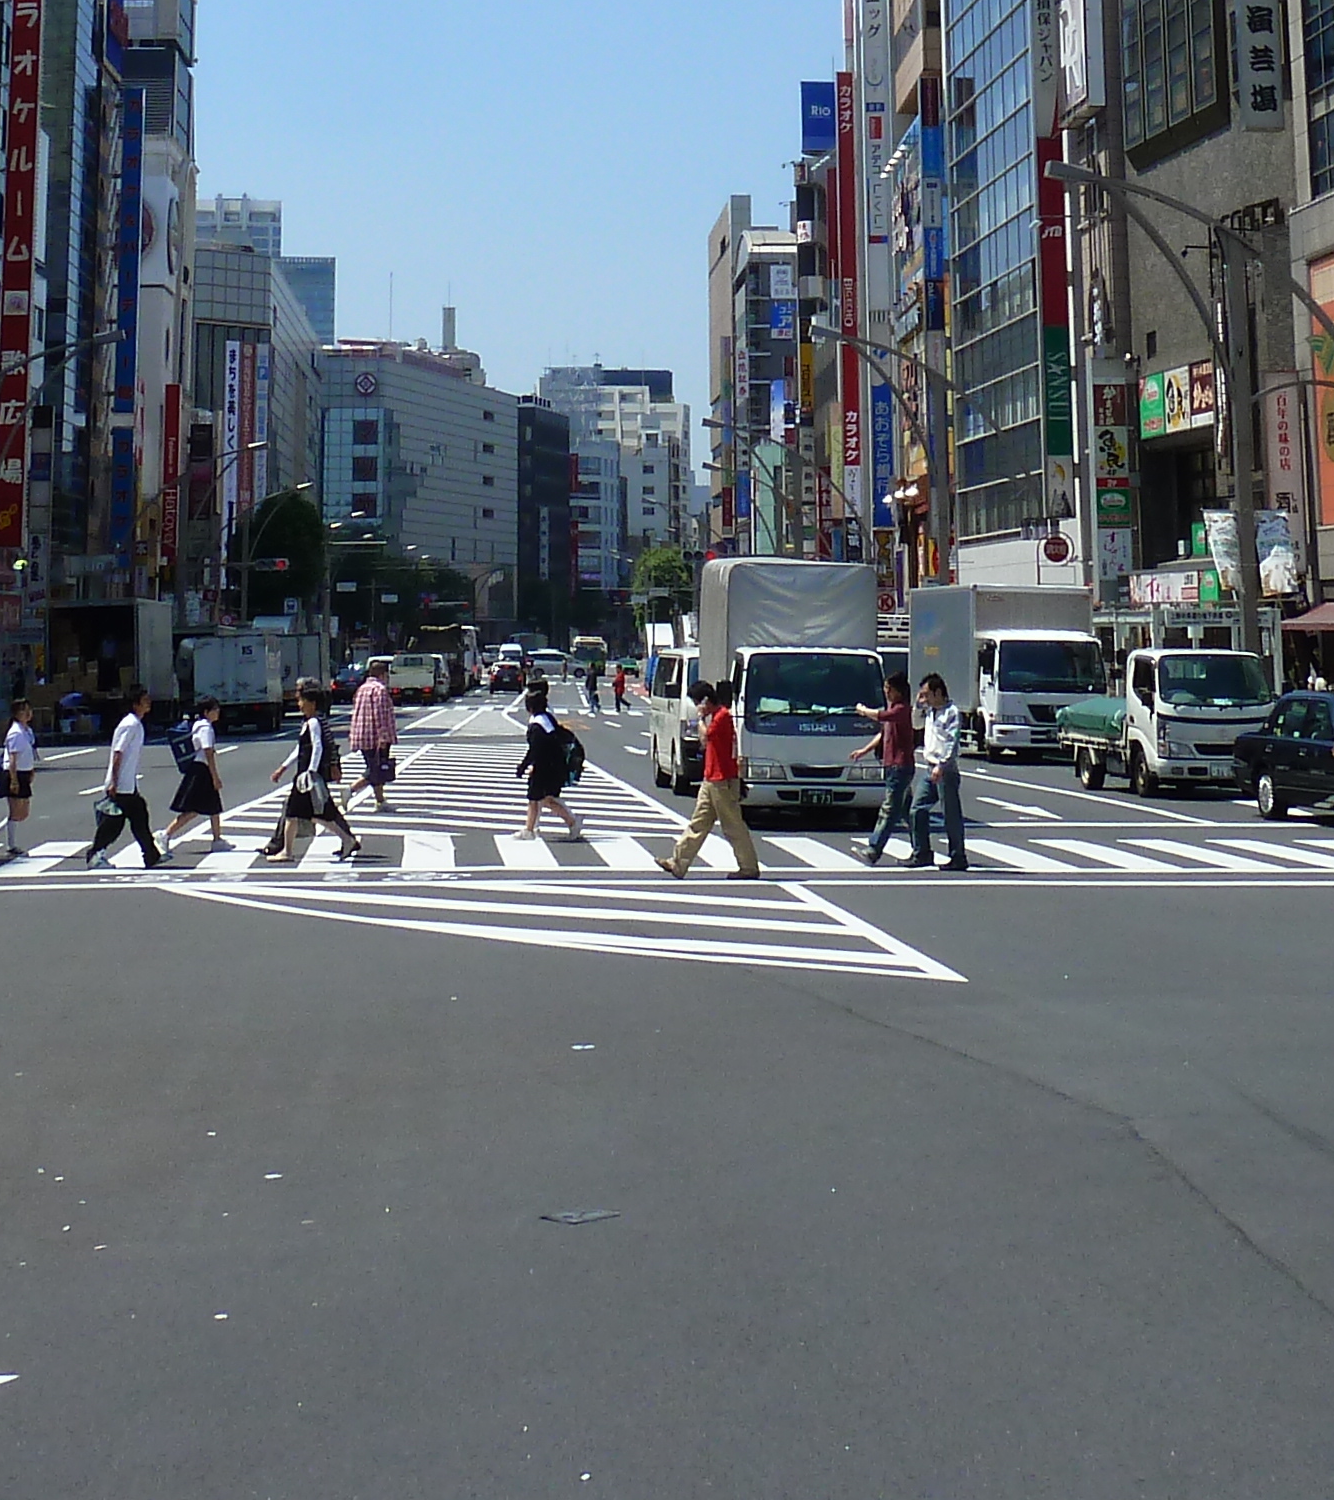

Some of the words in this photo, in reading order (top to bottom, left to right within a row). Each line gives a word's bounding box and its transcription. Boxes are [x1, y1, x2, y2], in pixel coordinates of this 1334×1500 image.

[811, 105, 831, 116] RIO
[839, 85, 853, 133] カラオケ
[845, 411, 860, 462] カラオケ
[1275, 394, 1291, 470] 百年の味の店
[798, 723, 836, 732] ISUZU
